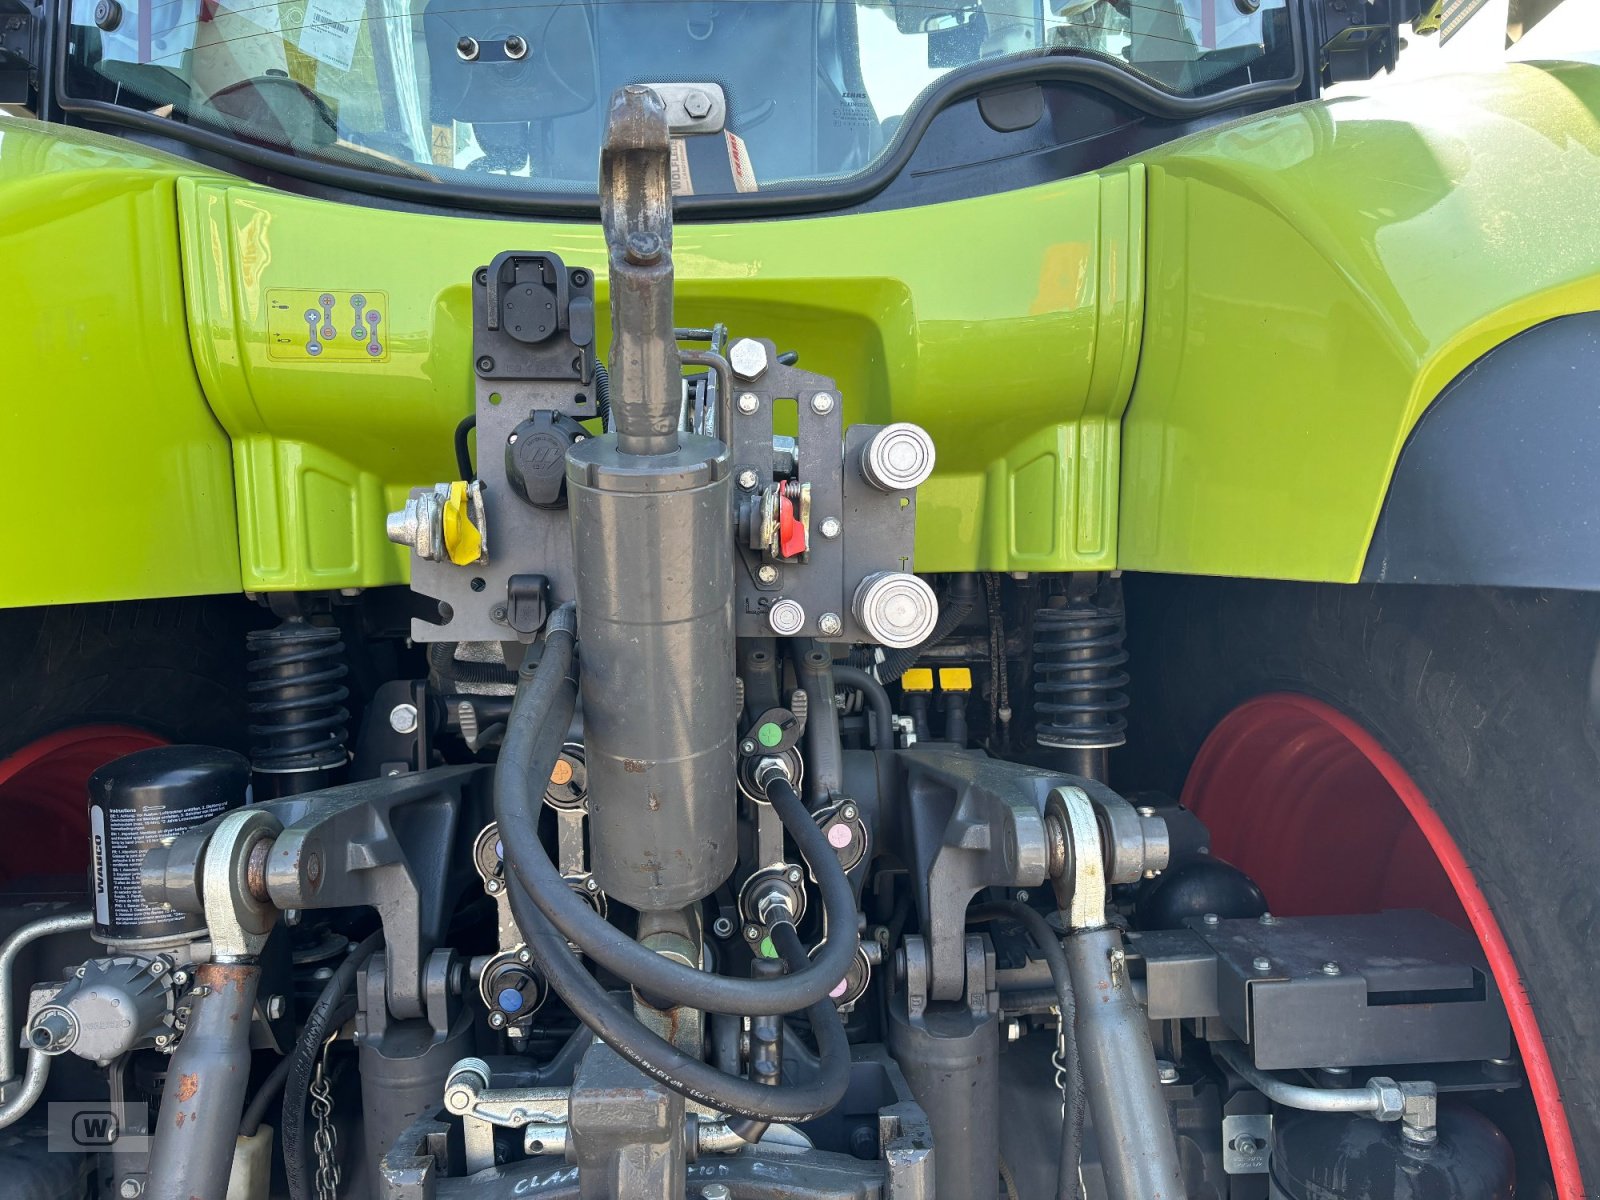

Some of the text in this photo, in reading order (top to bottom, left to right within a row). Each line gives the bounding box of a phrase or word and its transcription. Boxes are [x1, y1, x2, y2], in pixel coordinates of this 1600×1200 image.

[899, 556, 909, 571] T
[745, 596, 769, 615] LS
[95, 834, 104, 894] WABCO
[514, 1166, 580, 1194] CLAA
